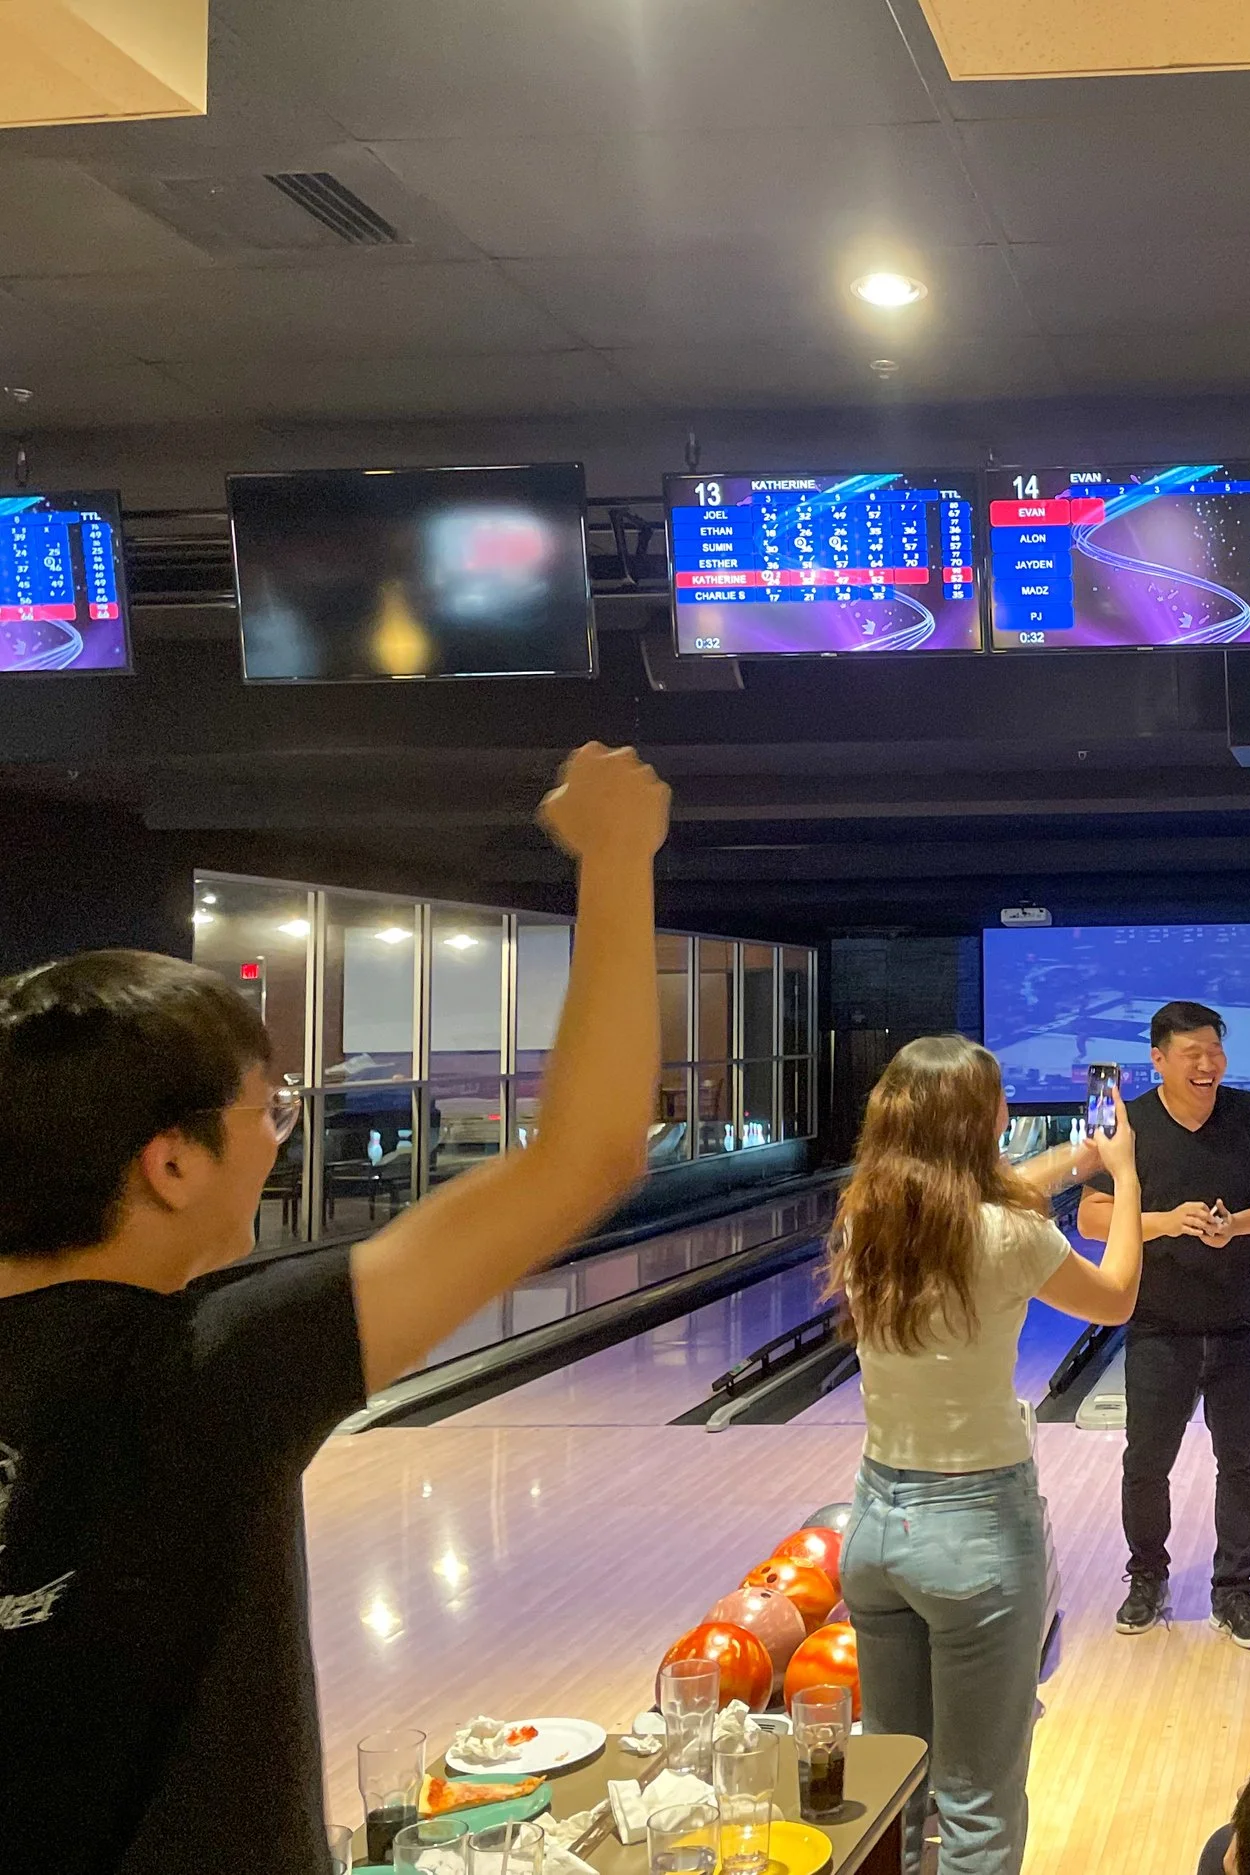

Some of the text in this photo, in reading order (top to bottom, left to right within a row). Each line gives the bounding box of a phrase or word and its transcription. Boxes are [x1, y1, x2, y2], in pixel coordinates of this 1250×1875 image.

[1070, 473, 1102, 483] EVAN
[751, 480, 816, 490] KATHERINE
[1012, 475, 1040, 500] 14
[694, 482, 720, 506] 13
[939, 490, 961, 499] TTL
[1084, 488, 1090, 496] 1
[1119, 487, 1125, 495] 2
[1154, 486, 1160, 494] 3
[1189, 485, 1195, 493] 4
[800, 494, 805, 503] 4
[905, 492, 911, 500] 7
[81, 512, 101, 520] TTL
[703, 511, 728, 520] JOEL
[868, 511, 881, 519] 57
[948, 510, 960, 518] 67
[1018, 508, 1045, 517] EVAN
[90, 531, 102, 539] 49
[700, 527, 733, 536] ETHAN
[1020, 534, 1046, 543] ALON
[92, 547, 103, 555] 25
[702, 543, 733, 552] SUMIN
[904, 543, 918, 551] 57
[949, 542, 962, 551] 57
[15, 548, 60, 557] 24 25
[93, 563, 105, 571] 46
[699, 559, 738, 568] ESTHER
[870, 560, 884, 568] 64
[905, 559, 919, 568] 70
[950, 558, 963, 567] 70
[1015, 560, 1053, 570] JAYDEN
[17, 565, 29, 573] 37
[94, 579, 106, 587] 49
[692, 575, 747, 584] KATHERINE
[18, 580, 64, 589] 45 49
[1021, 586, 1049, 595] MADZ
[695, 591, 746, 601] CHARLIE S
[769, 594, 780, 602] 17
[1031, 612, 1042, 621] PJ
[1020, 632, 1044, 643] 0:32
[695, 638, 720, 649] 0:32
